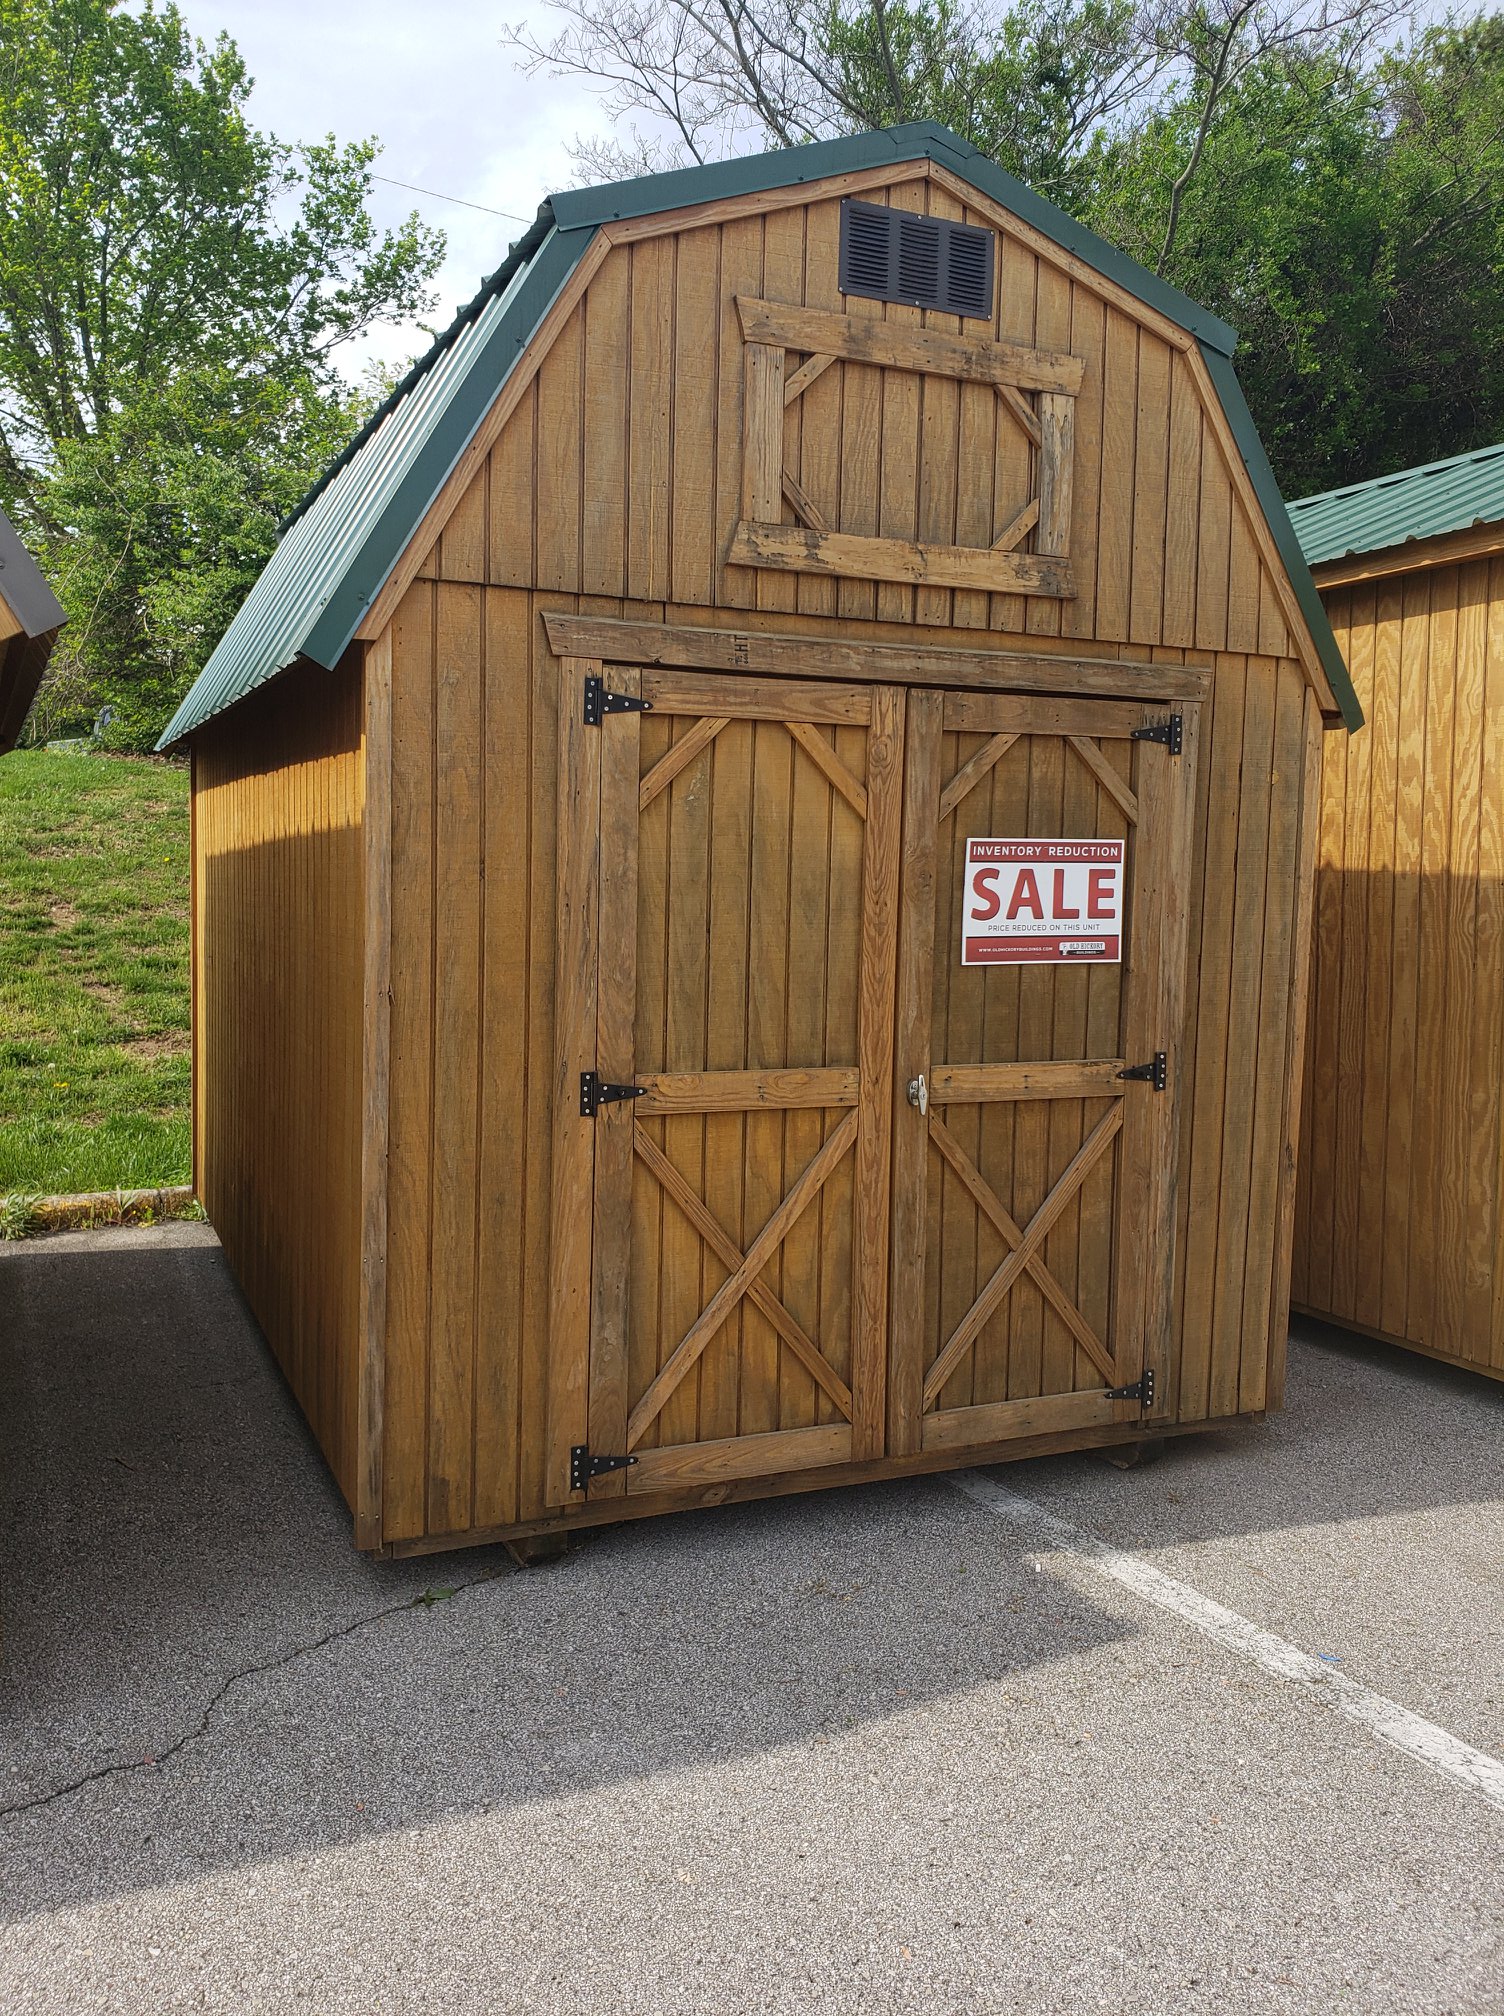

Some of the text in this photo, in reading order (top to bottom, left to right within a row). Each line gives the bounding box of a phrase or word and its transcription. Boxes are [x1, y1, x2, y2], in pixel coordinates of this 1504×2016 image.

[973, 845, 1119, 857] INVENTORY REDUCTION
[970, 867, 1116, 922] SALE
[988, 924, 1010, 932] PRICE
[1012, 924, 1047, 932] REDUCED
[1082, 923, 1101, 931] UNIT
